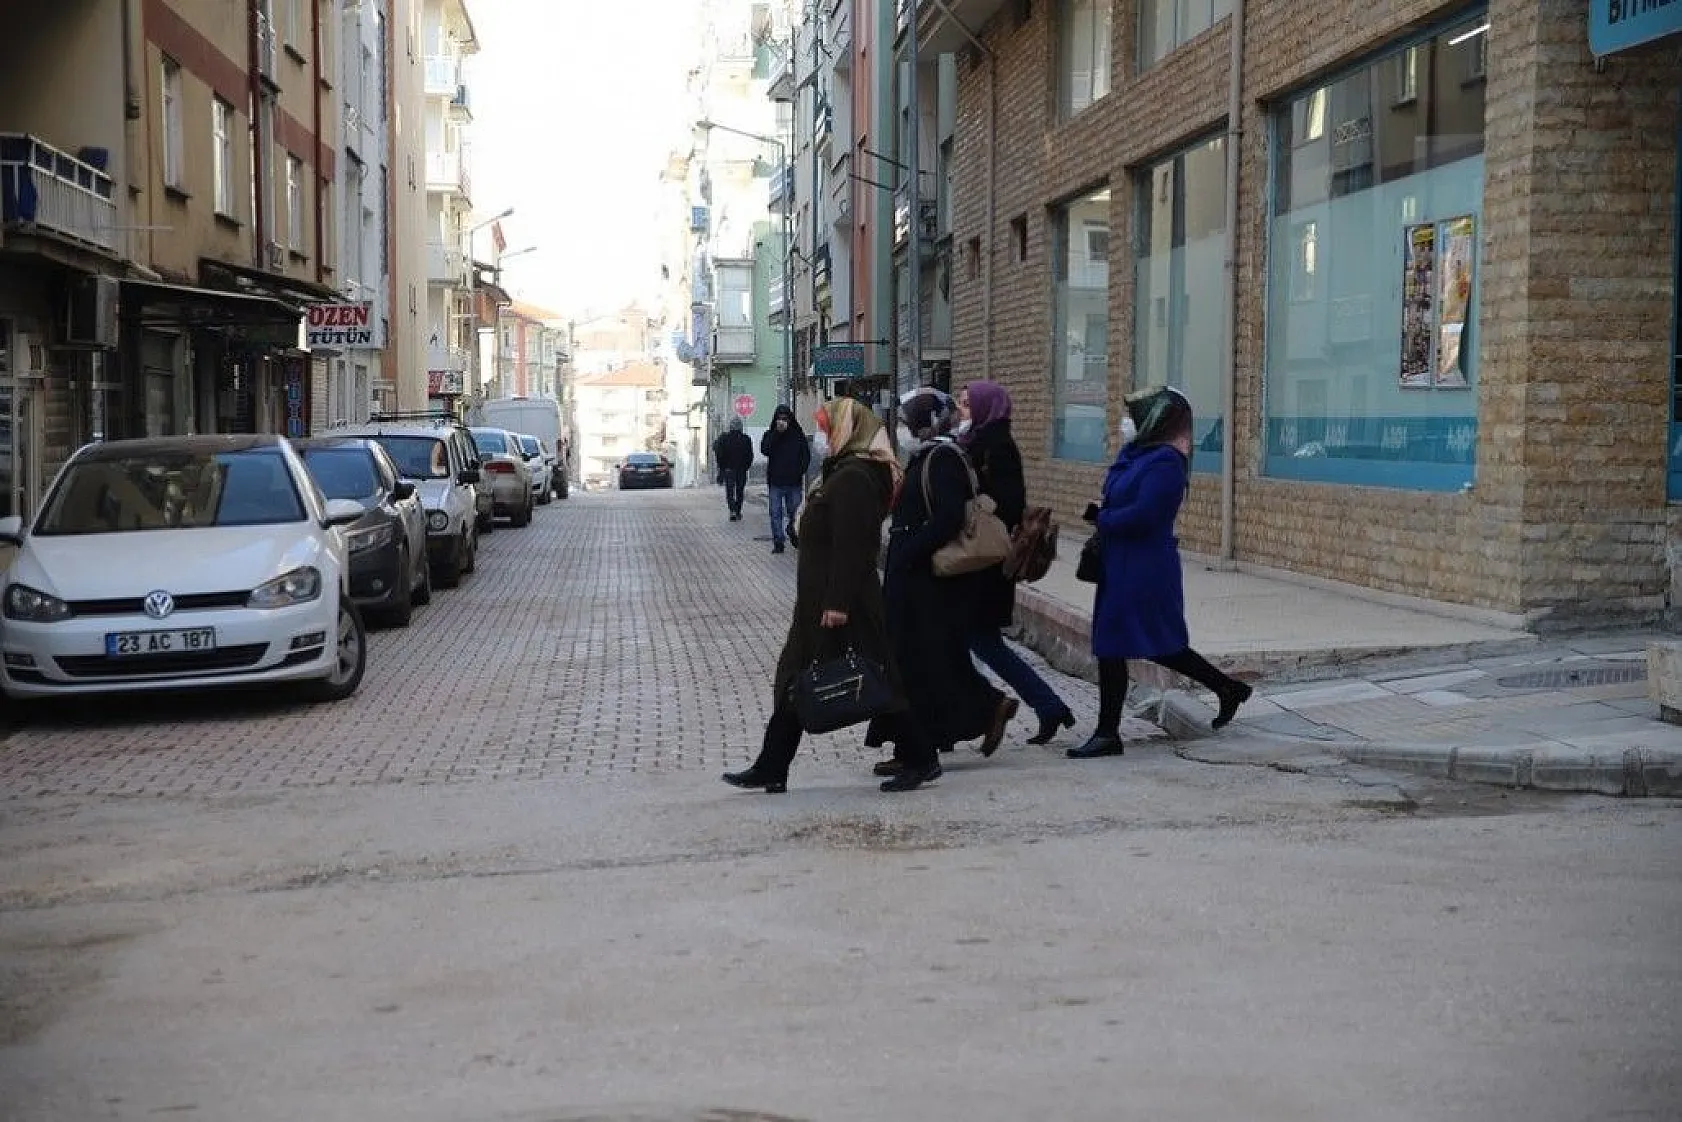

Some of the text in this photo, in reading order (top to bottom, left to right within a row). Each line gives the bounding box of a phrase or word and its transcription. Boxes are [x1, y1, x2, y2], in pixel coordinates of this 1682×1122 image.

[308, 327, 371, 344] TÜTÜN
[119, 630, 211, 652] 23 AC 187
